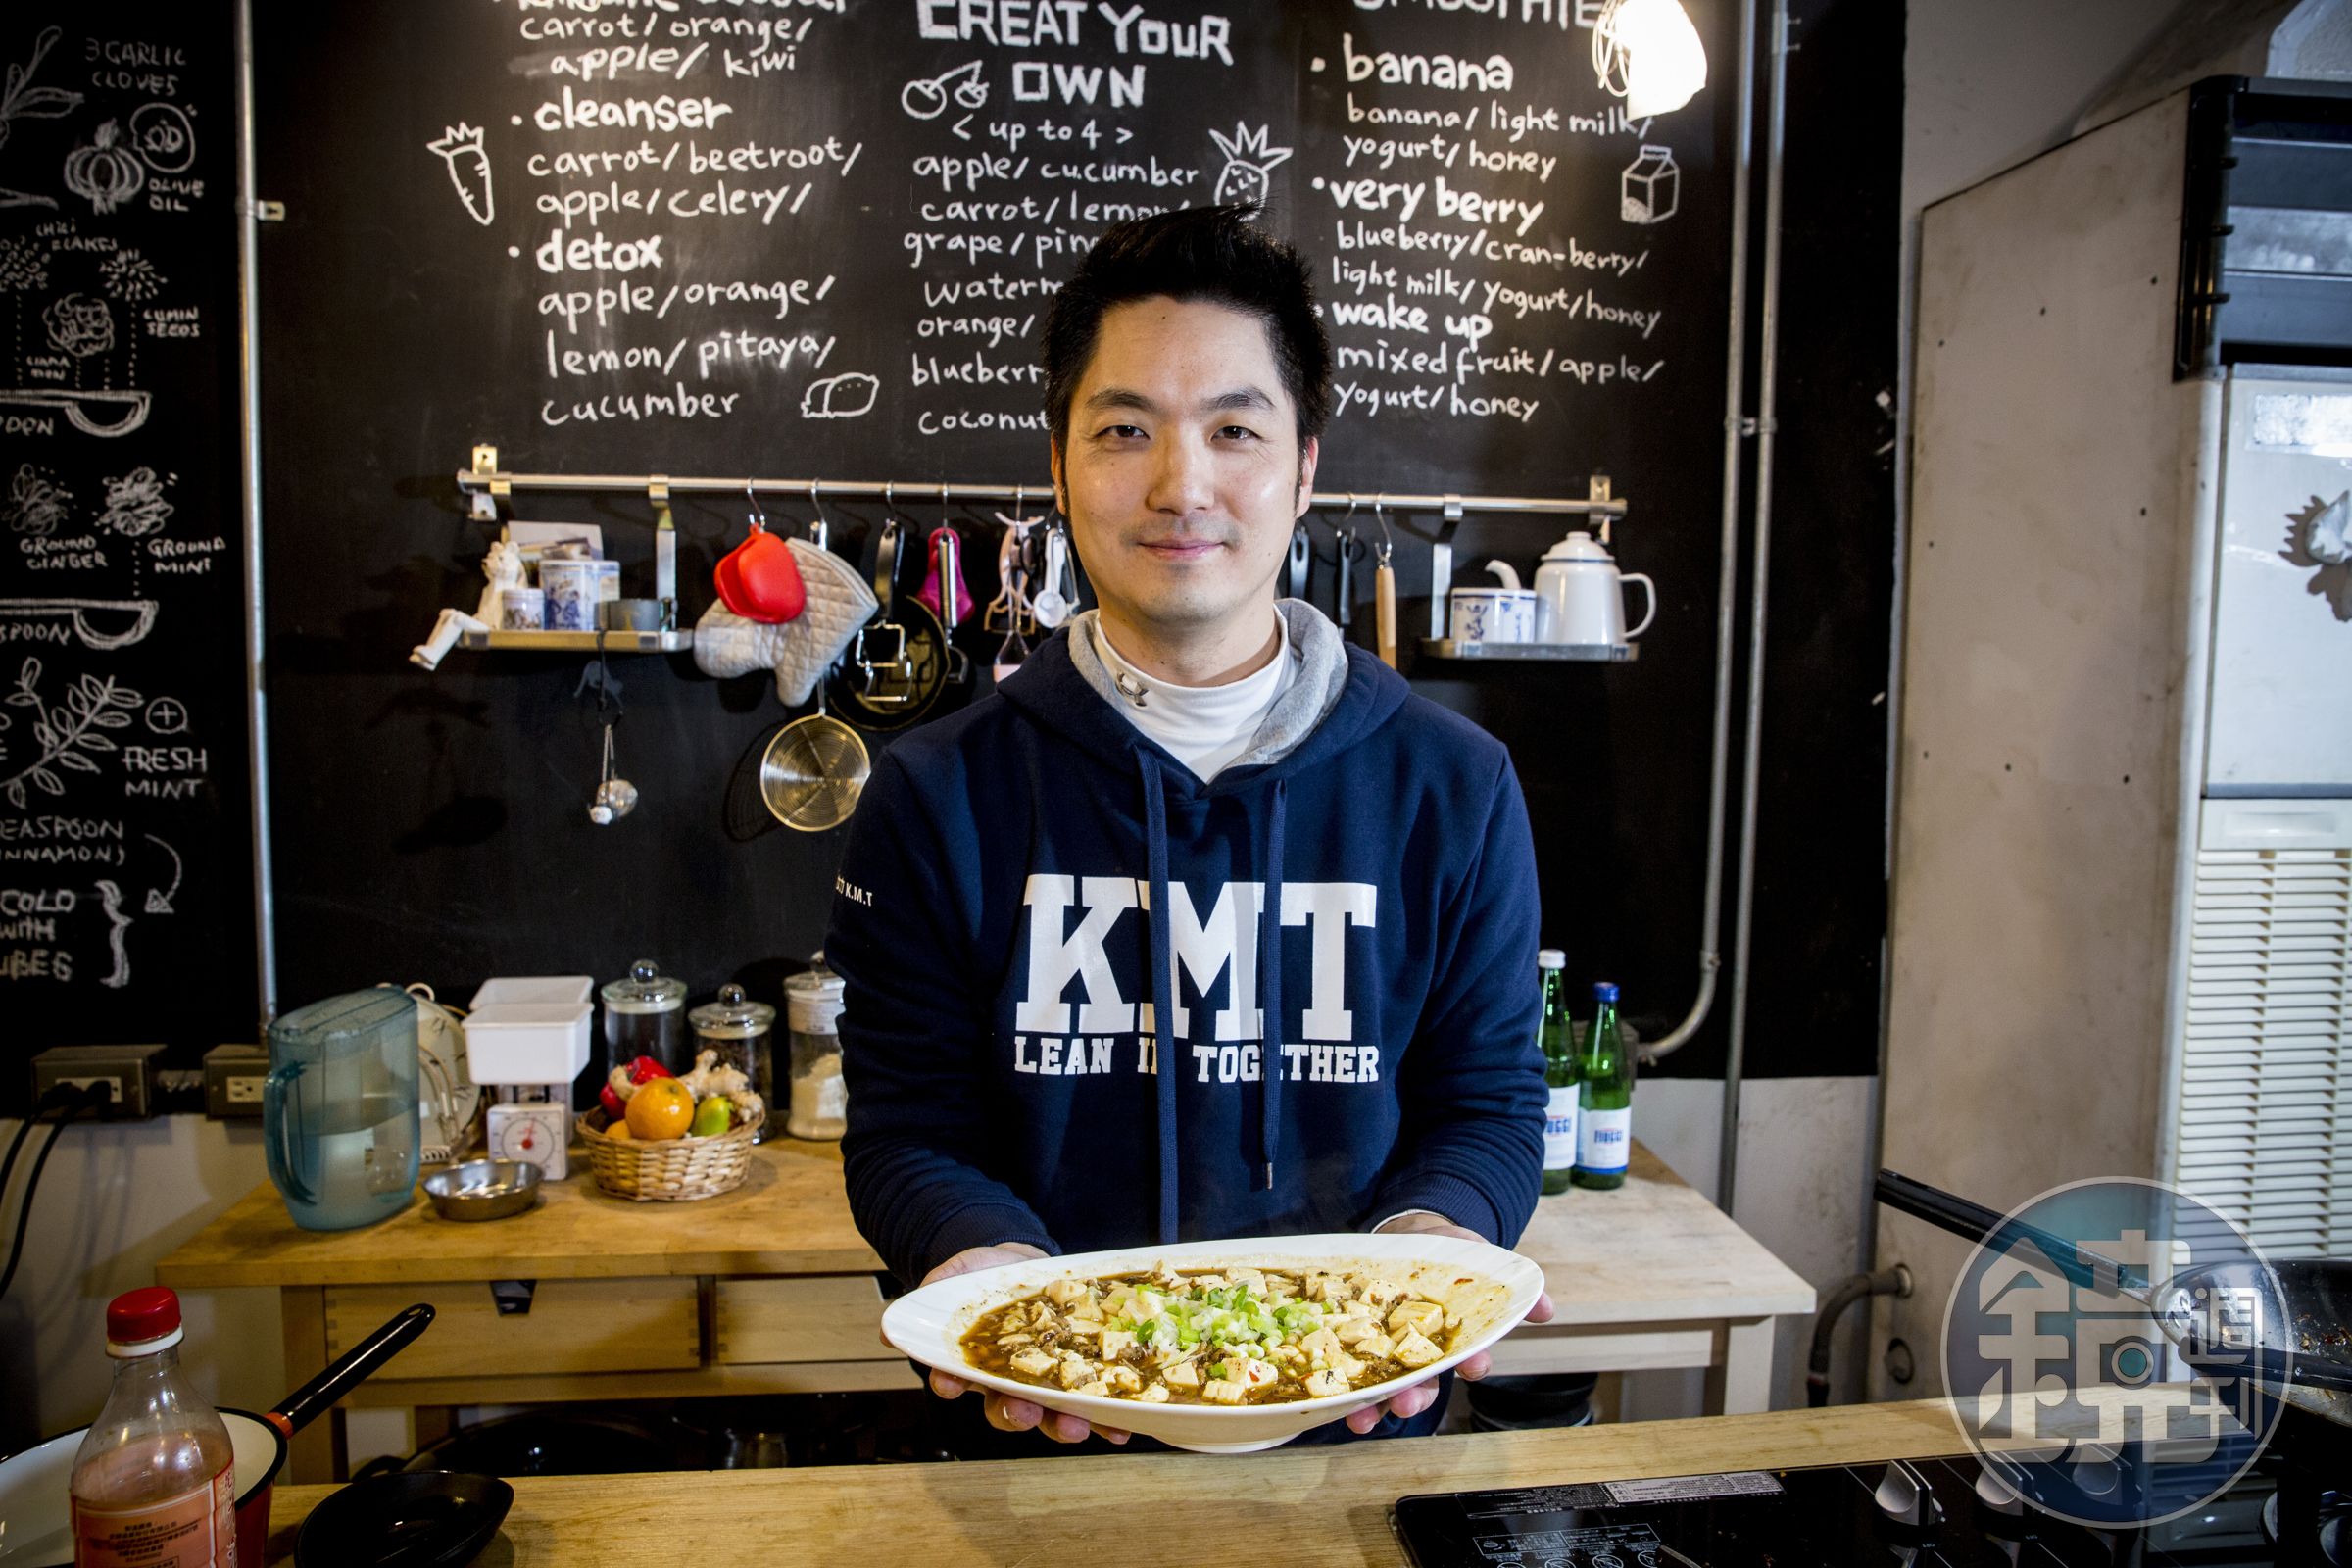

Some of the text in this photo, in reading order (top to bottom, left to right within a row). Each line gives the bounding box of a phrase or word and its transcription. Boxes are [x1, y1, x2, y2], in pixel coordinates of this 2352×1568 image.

[917, 0, 1088, 47] CREAT
[104, 39, 188, 67] GARLIC
[722, 45, 798, 78] kiwi
[1343, 33, 1514, 92] banana
[91, 70, 180, 97] CLOVES
[1011, 62, 1147, 108] OWN
[534, 84, 733, 132] cleanser
[1490, 100, 1560, 143] light
[989, 120, 1026, 153] up
[1040, 156, 1200, 187] cucumber
[148, 197, 190, 213] OIL
[1330, 176, 1544, 236] very berry
[535, 228, 663, 273] detox
[1333, 256, 1397, 295] light
[917, 314, 1035, 348] orange/
[1331, 294, 1494, 353] wake up
[1337, 339, 1448, 374] mixed
[541, 381, 741, 426] cucumber
[19, 534, 98, 557] GROUND
[25, 550, 109, 570] GINGER
[146, 535, 227, 557] GROUND
[153, 557, 212, 575] MINT
[121, 744, 209, 774] FRESH
[124, 778, 204, 801] MINT
[1016, 873, 1377, 1042] KMT
[1014, 1035, 1114, 1076] LEAN
[1192, 1043, 1380, 1083] TOGTHER
